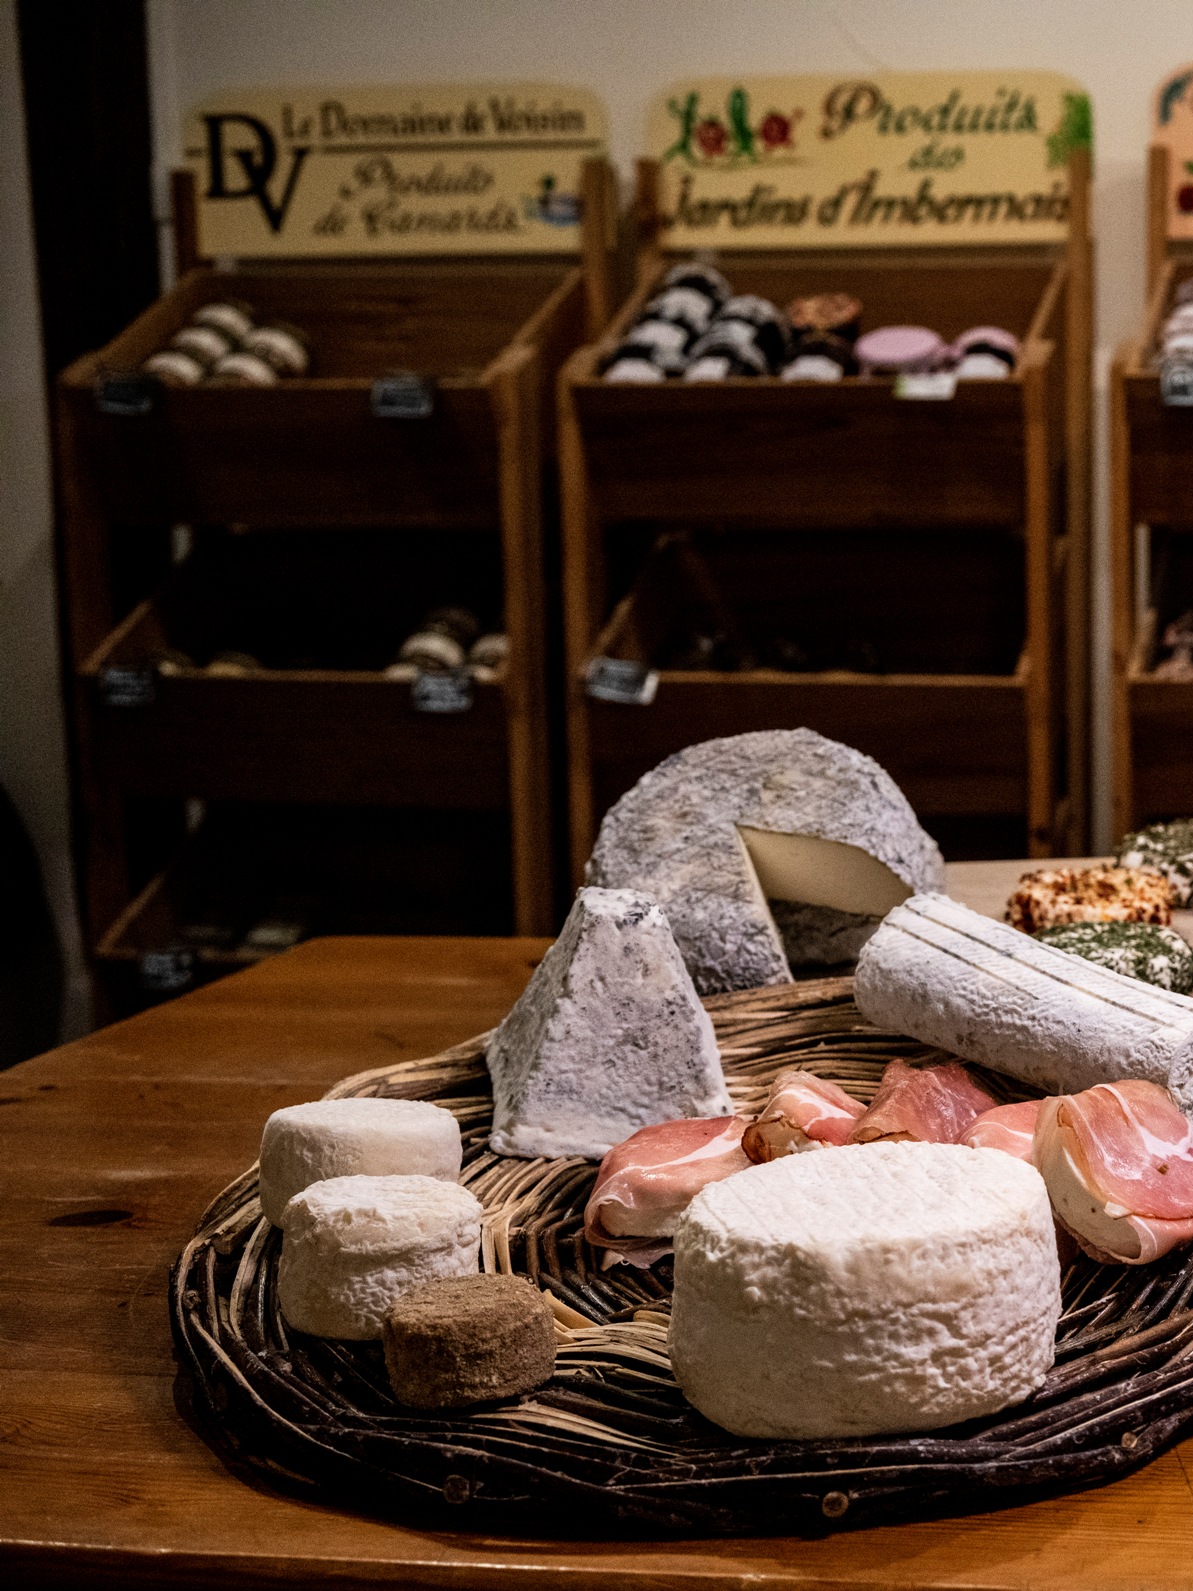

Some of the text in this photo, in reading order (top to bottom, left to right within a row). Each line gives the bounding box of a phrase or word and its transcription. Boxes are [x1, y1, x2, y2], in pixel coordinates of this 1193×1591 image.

[282, 102, 313, 139] Le
[319, 100, 454, 138] Domaine
[459, 99, 486, 135] de
[820, 80, 1040, 141] Produits
